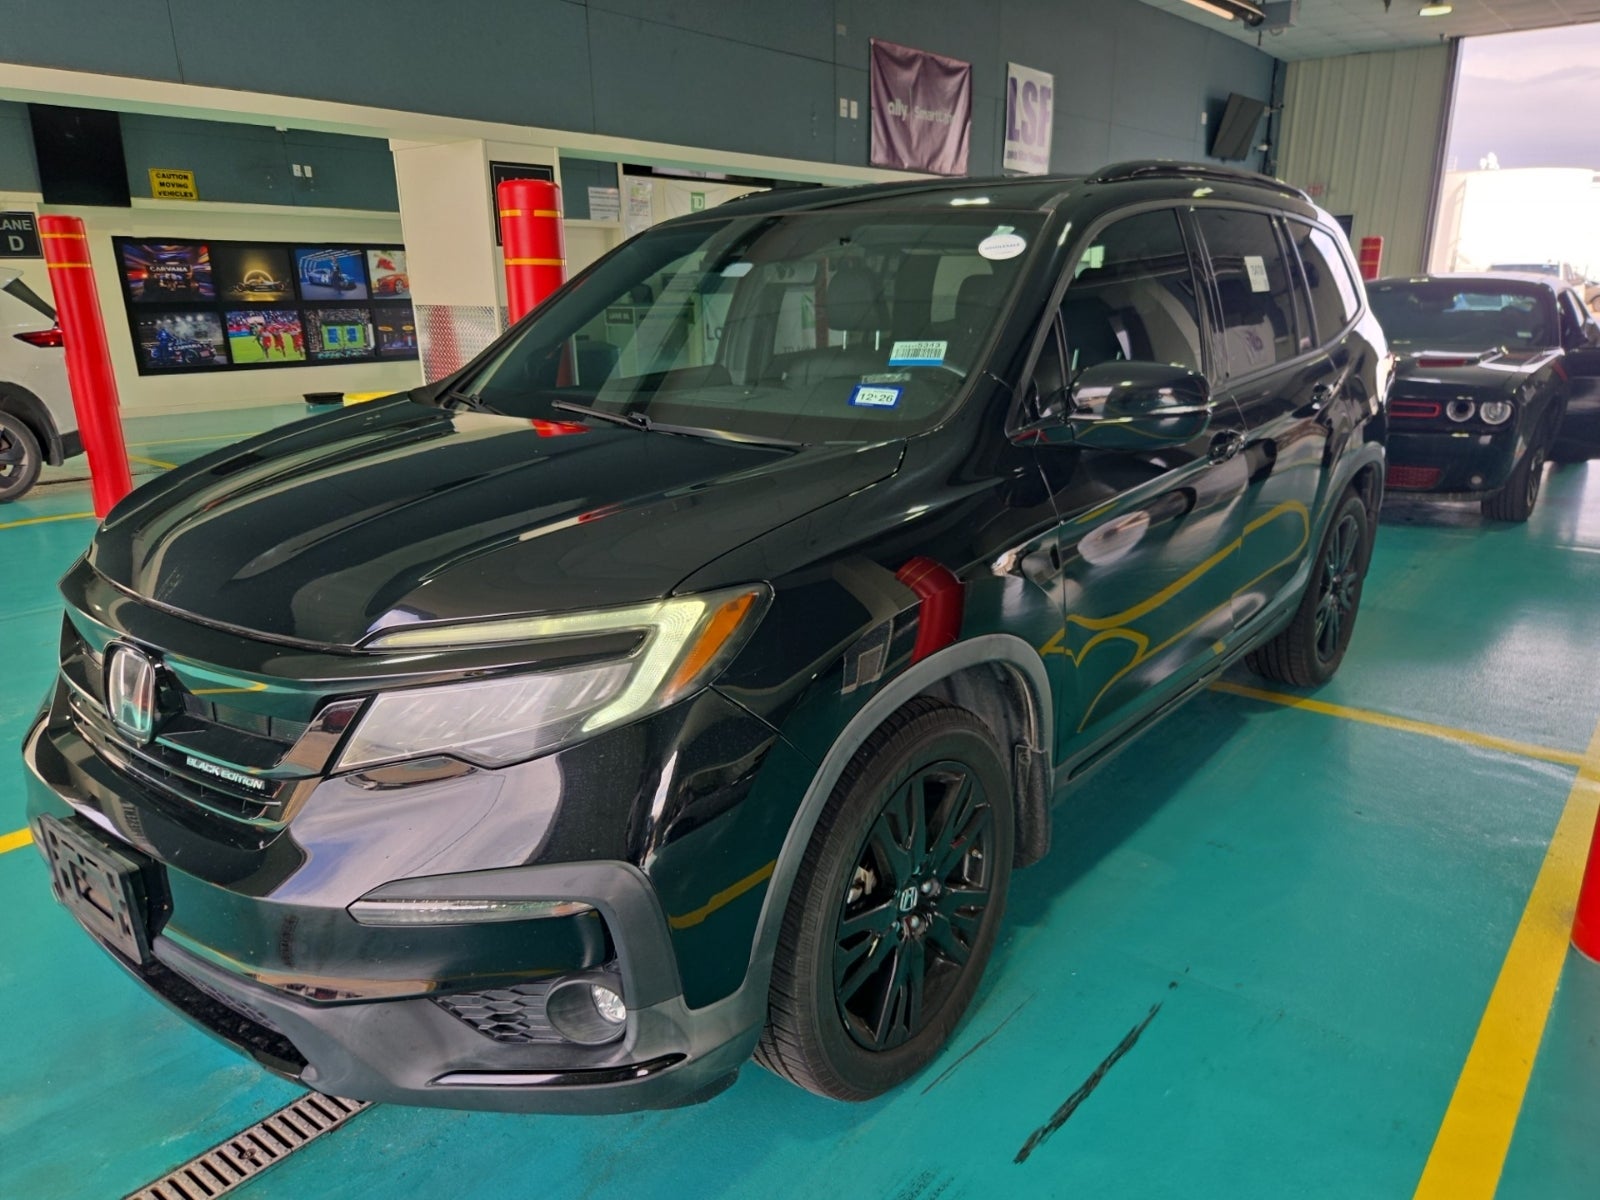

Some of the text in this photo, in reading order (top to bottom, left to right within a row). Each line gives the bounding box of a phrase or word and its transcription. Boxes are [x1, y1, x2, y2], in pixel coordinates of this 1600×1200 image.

[888, 98, 908, 121] ally
[0, 219, 33, 231] ANE
[8, 235, 25, 251] D
[149, 265, 188, 273] CARVANA
[860, 393, 894, 402] 12 26
[186, 756, 265, 790] BLACK EDITION
